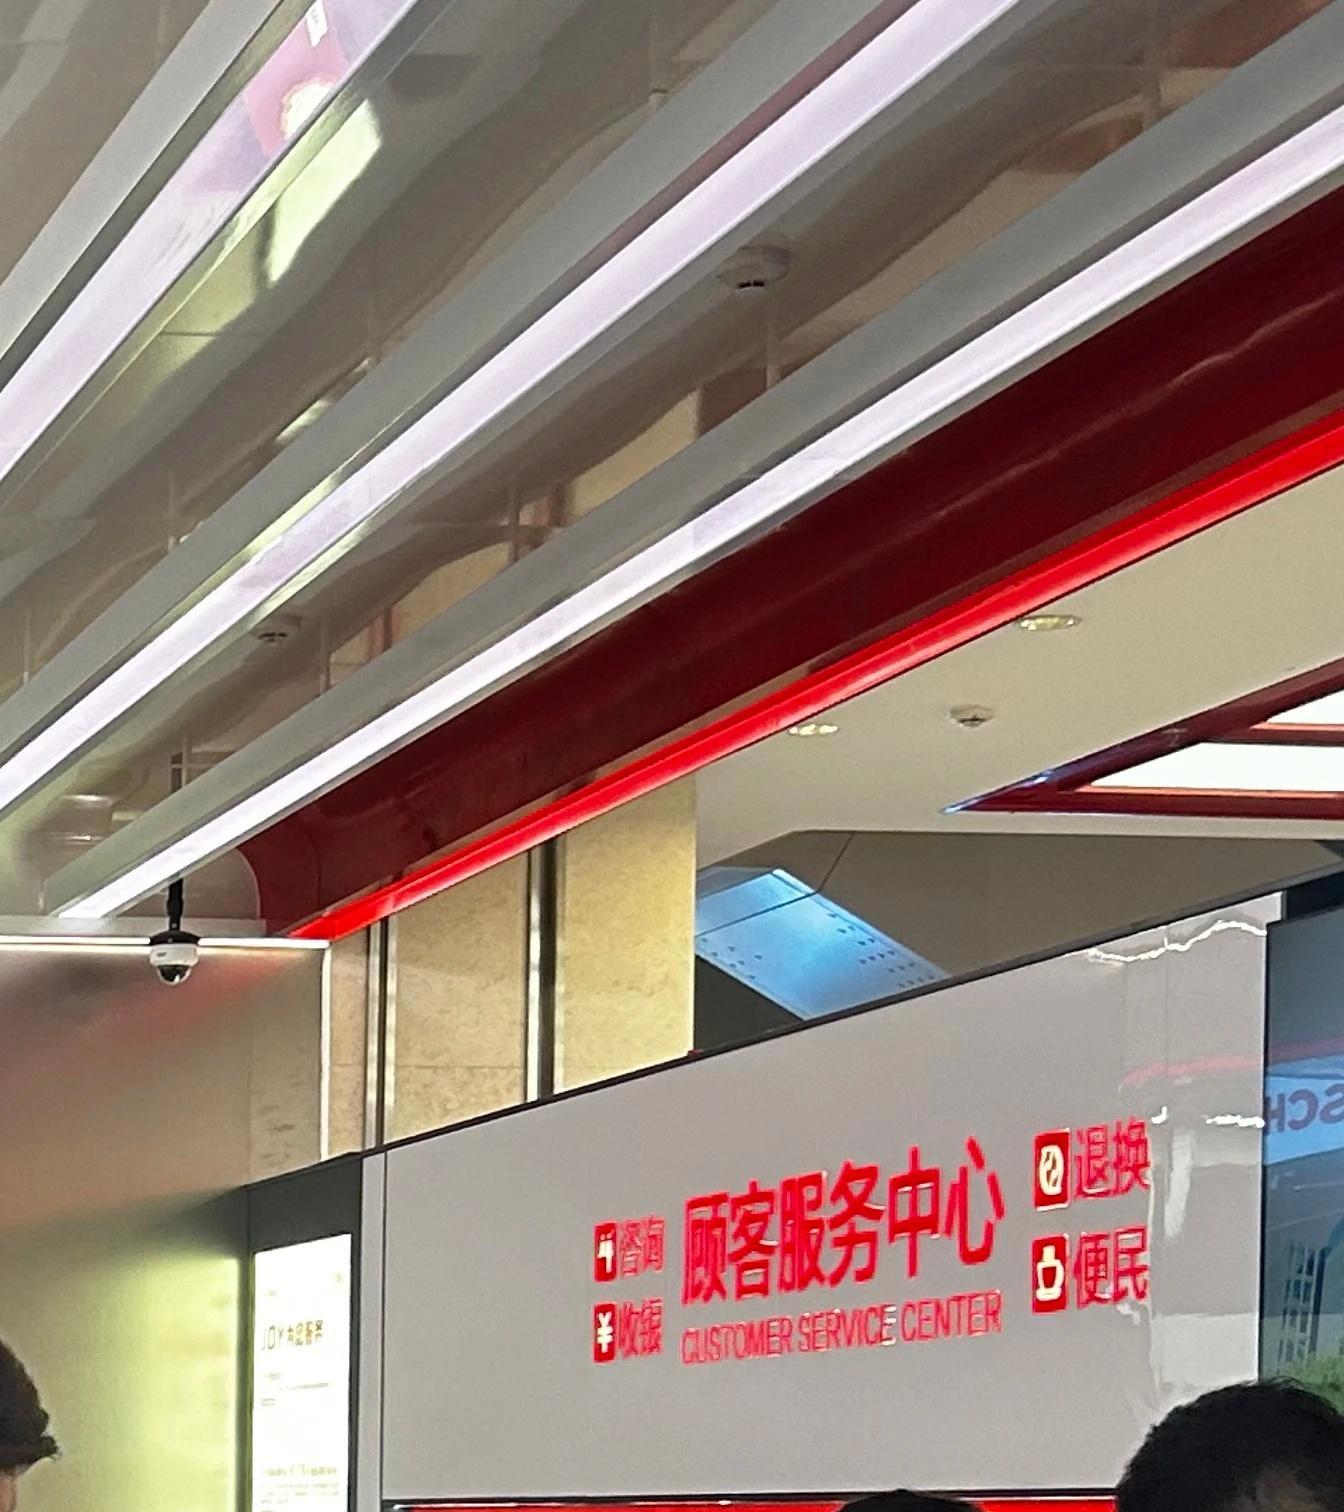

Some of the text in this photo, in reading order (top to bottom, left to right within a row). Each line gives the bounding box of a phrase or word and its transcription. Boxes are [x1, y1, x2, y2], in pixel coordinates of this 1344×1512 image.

[1074, 1116, 1150, 1200] 退换
[682, 1136, 1005, 1305] 顾客服务中心
[1074, 1224, 1150, 1309] 便民
[681, 1289, 1003, 1366] CUSTOMER SERVICE CENTER
